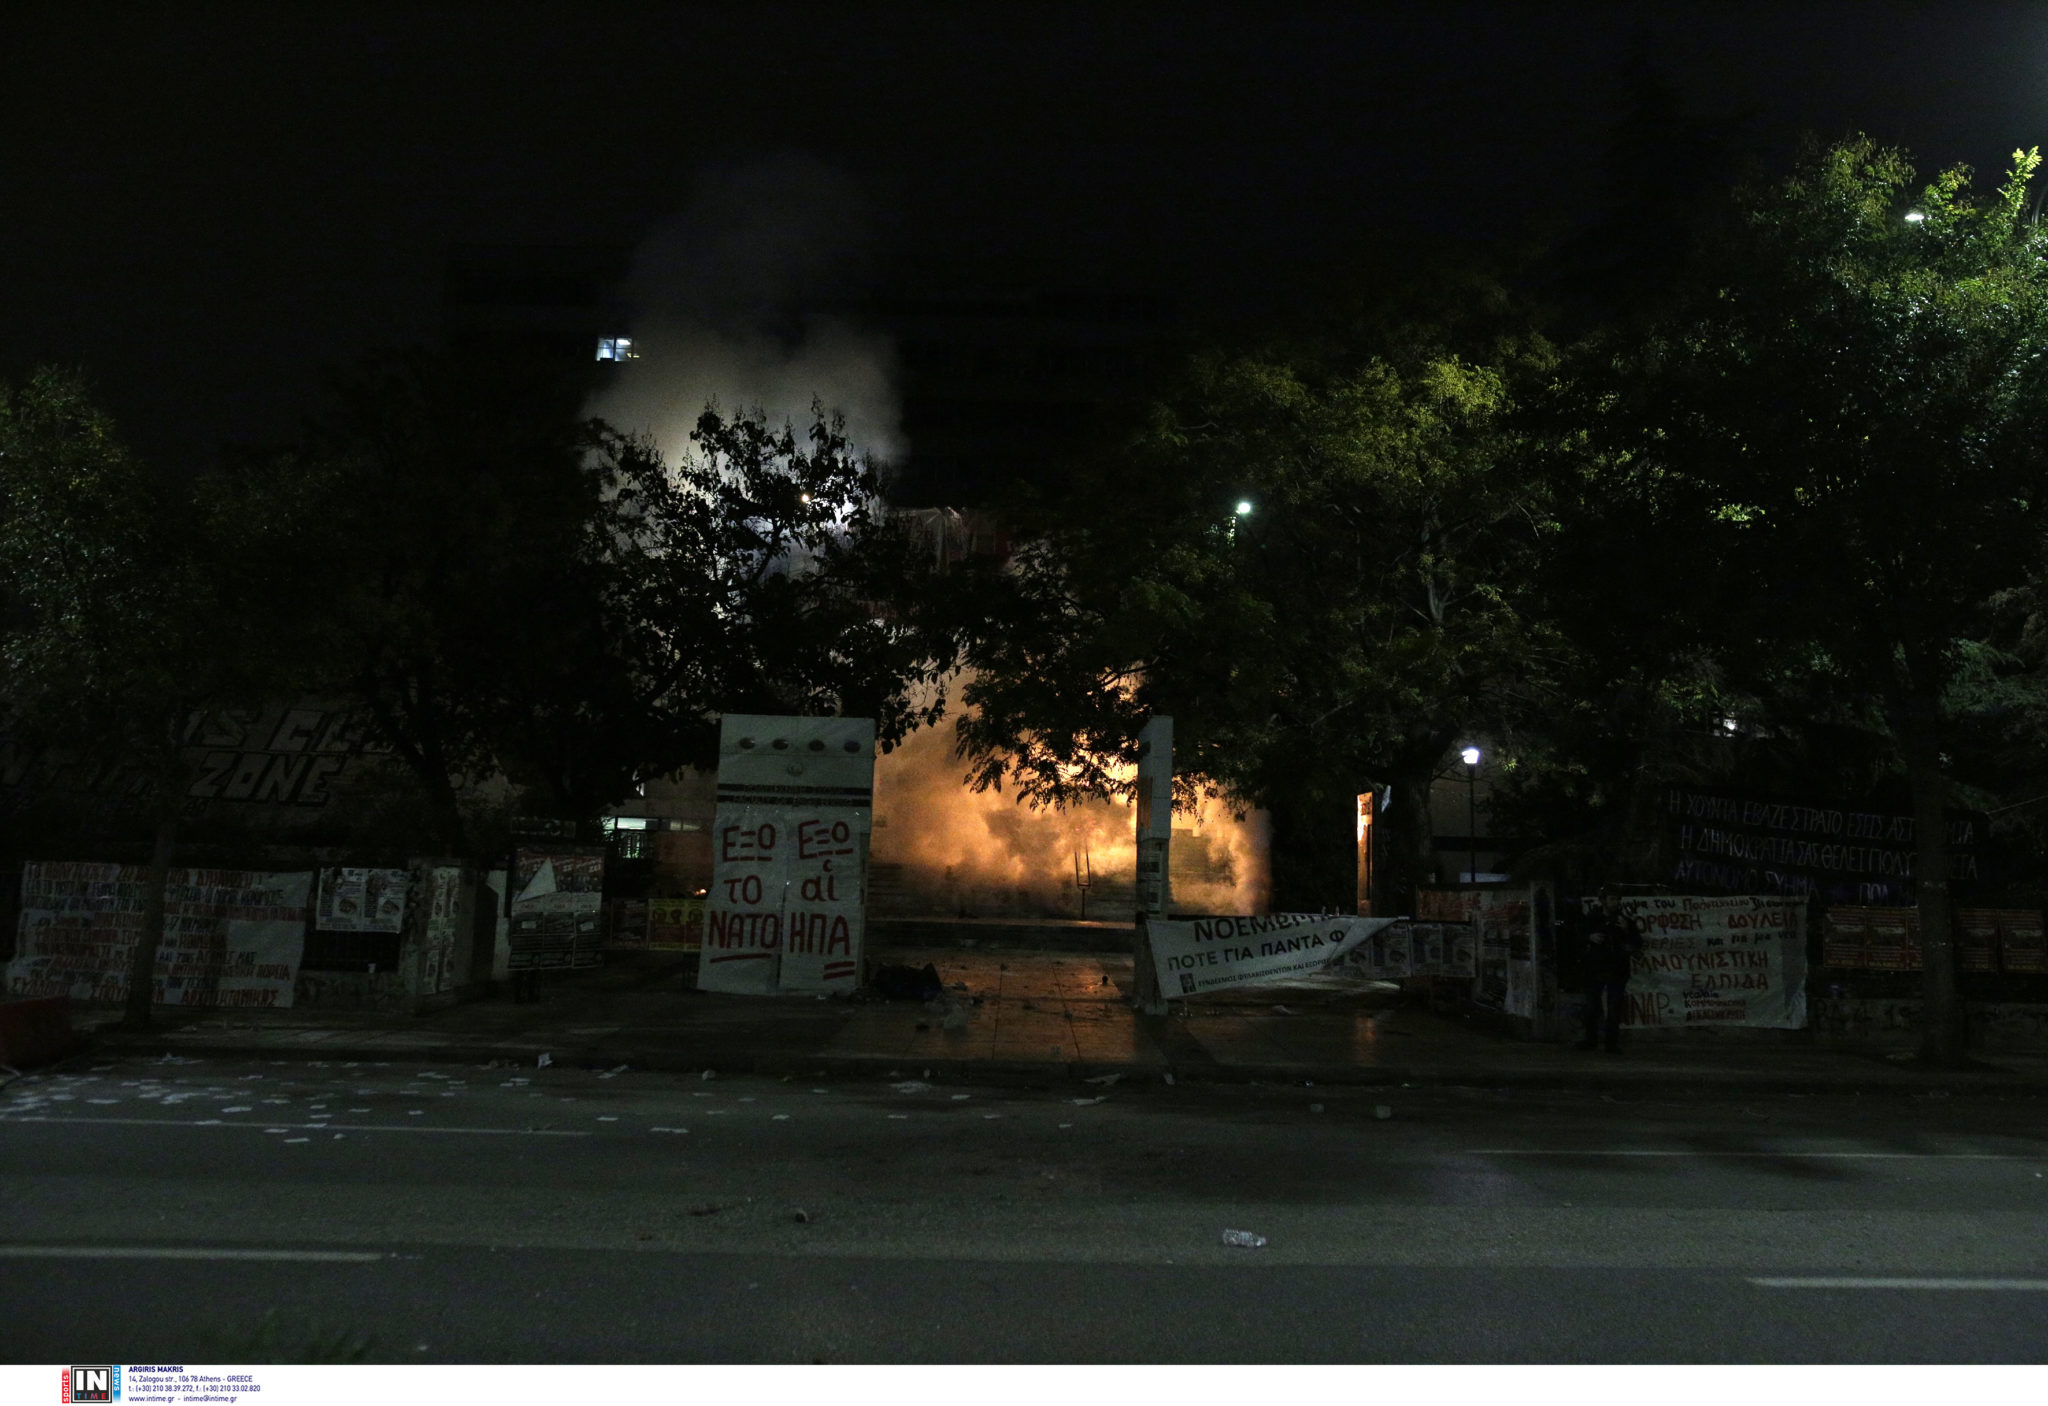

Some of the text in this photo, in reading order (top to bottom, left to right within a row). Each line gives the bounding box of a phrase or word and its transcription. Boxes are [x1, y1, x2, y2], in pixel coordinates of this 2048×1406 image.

[185, 751, 348, 806] ZONE
[1670, 790, 1681, 814] Η
[1686, 794, 1738, 823] ΧΟΥΝΤΑ
[1680, 824, 1693, 849] Η
[1696, 827, 1795, 866] ΔΗΜΟΚΡΑΤΙΑ
[708, 910, 781, 949] ΝΑΤΟ
[789, 911, 850, 955] ΗΠΑ
[1635, 911, 1798, 935] ΟΡΦΩΣΗ ΔΟΥΛΕΙΑ
[1167, 951, 1218, 972] ΠΟΤΕ
[1223, 946, 1254, 963] ΓΙΑ
[1260, 933, 1325, 957] ΠΑΝΤΑ
[1293, 962, 1305, 971] ΚΑΙ
[1632, 952, 1769, 976] ΜΜΟΥΝΙΣΤΙΚΗ
[1691, 973, 1770, 991] ΕΛΠΙΔΑ
